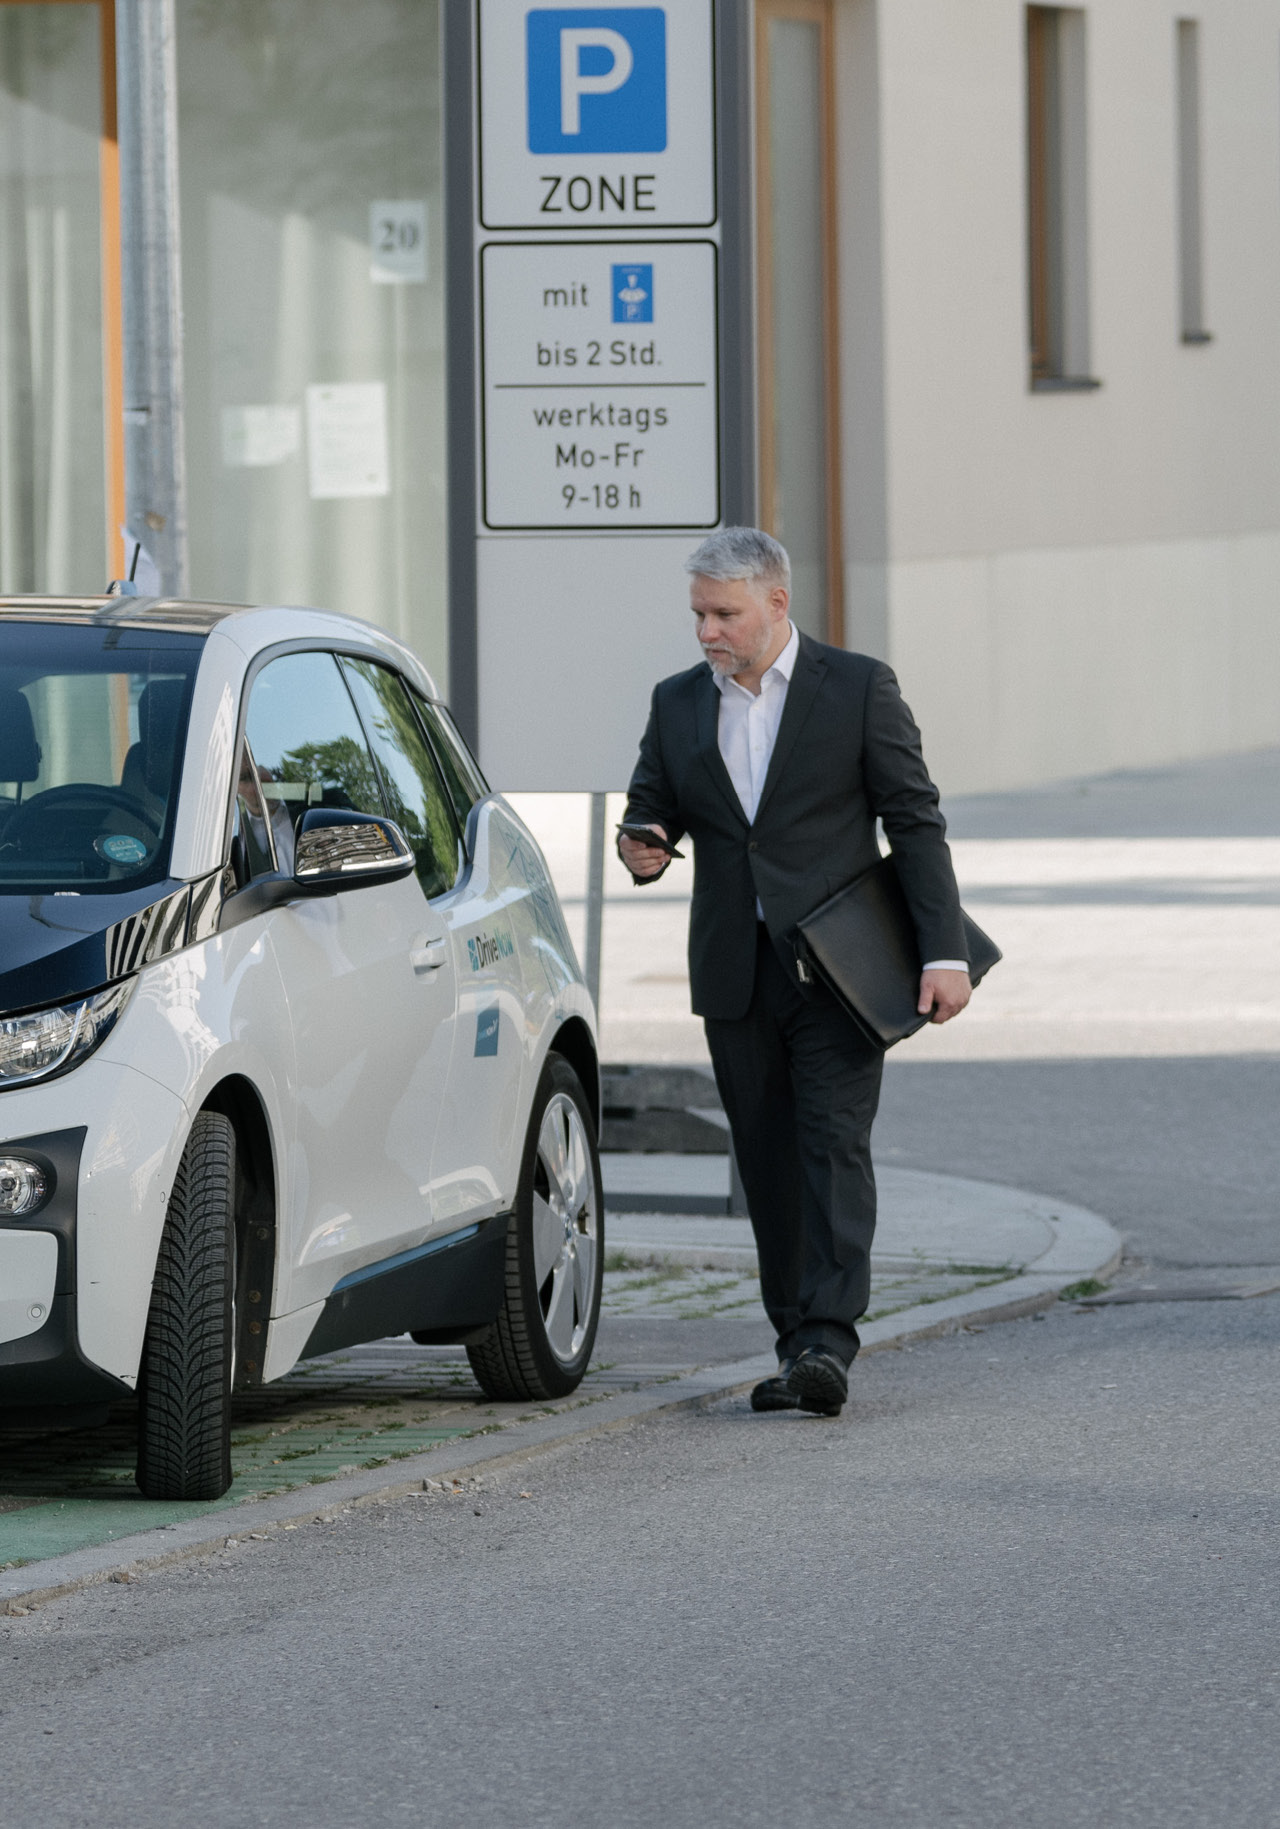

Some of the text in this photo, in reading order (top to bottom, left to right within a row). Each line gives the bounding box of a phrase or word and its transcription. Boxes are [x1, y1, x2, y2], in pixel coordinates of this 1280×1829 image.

[560, 27, 633, 136] P
[540, 175, 655, 212] ZONE
[380, 219, 420, 252] 20
[543, 282, 588, 307] mit
[537, 341, 662, 366] bis 2 Std.
[533, 402, 668, 432] werktags
[555, 442, 645, 468] Mo-Fr
[562, 484, 641, 509] 9-18 h
